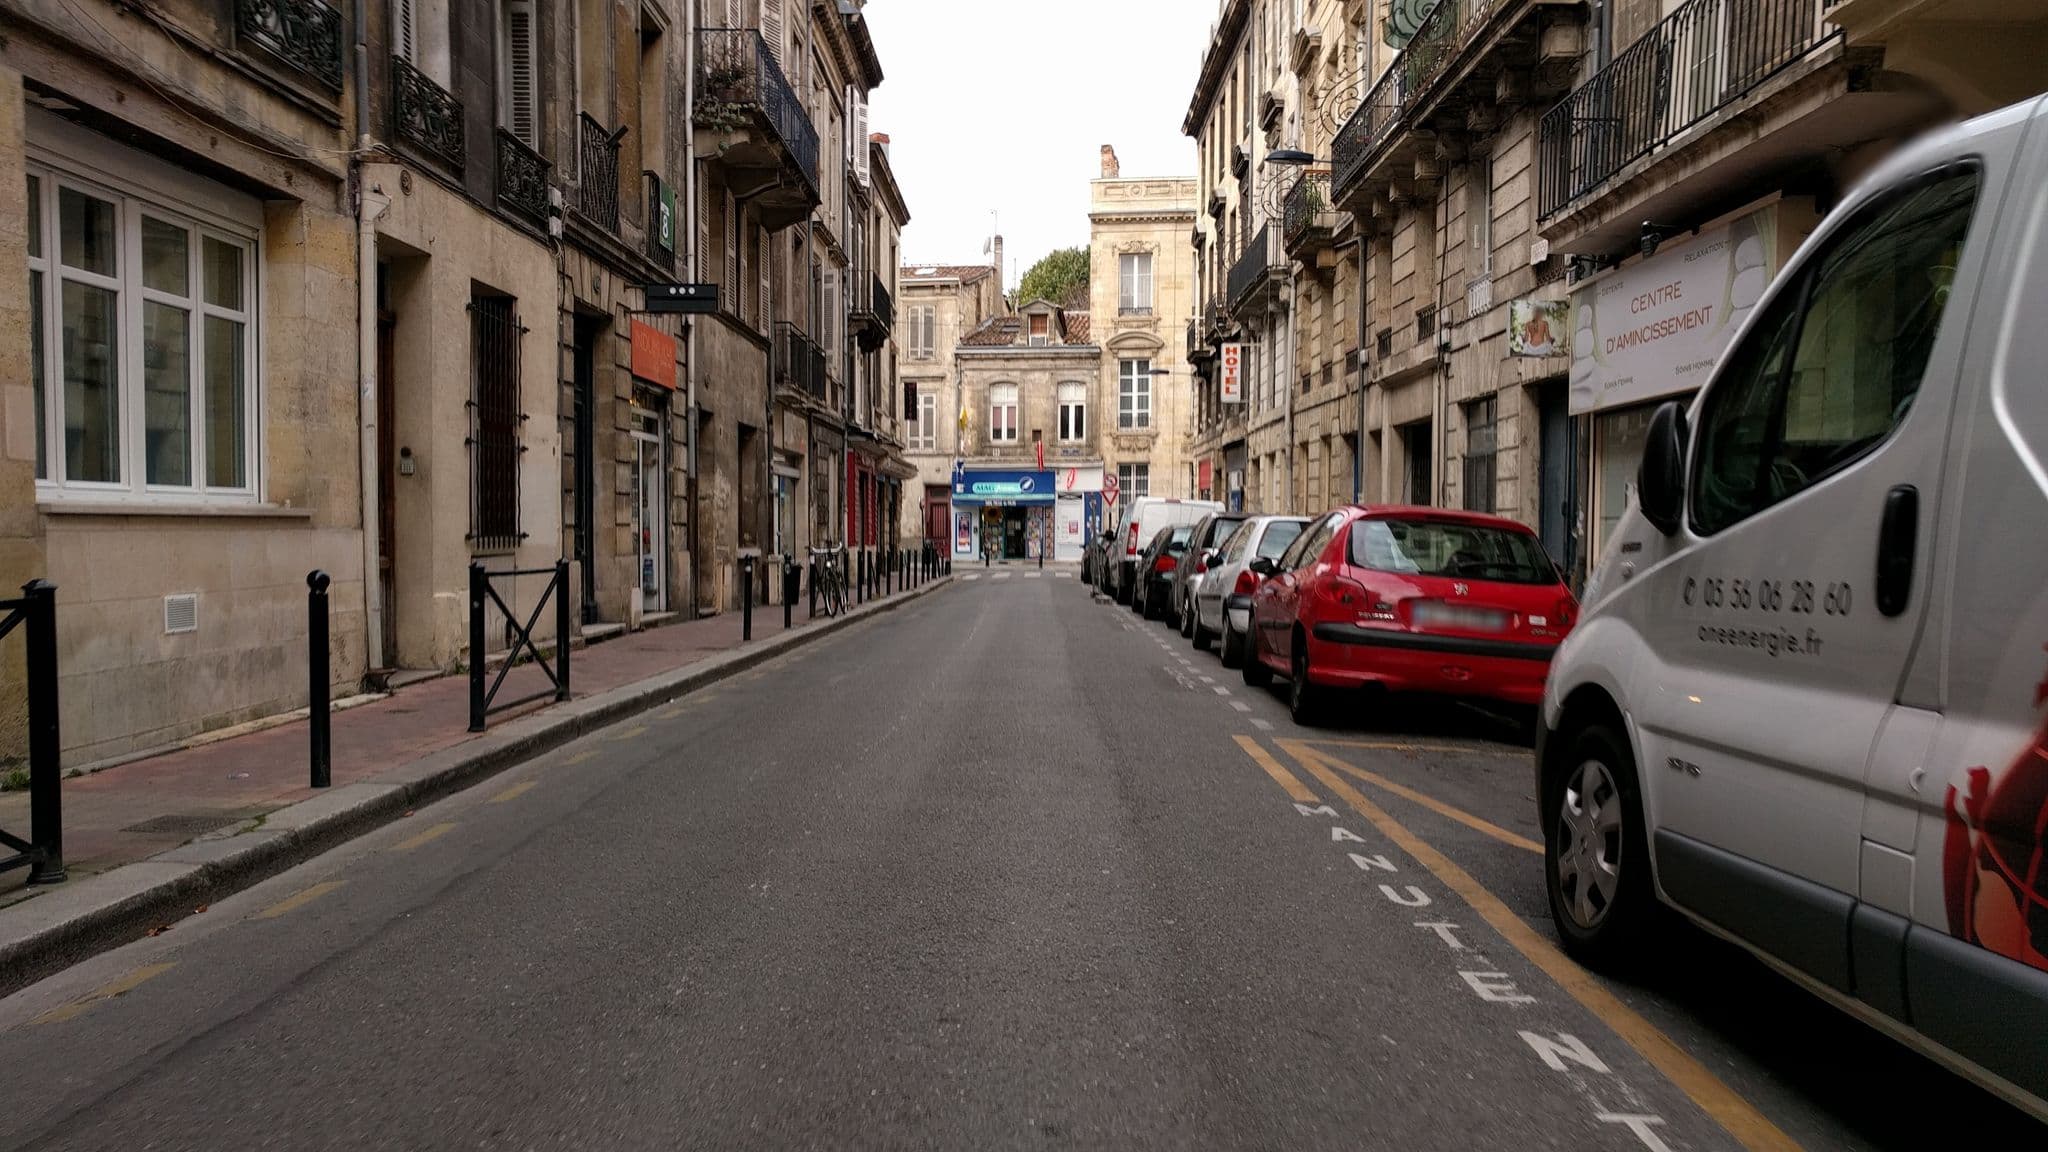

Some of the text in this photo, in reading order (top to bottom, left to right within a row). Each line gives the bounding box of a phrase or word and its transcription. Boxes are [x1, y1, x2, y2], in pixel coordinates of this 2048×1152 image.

[1630, 280, 1682, 314] CENTRE
[1606, 305, 1713, 354] D'AMINCISSEMENT
[1225, 347, 1238, 395] HOTEL
[1704, 577, 1852, 616] 05 56 06 28 60
